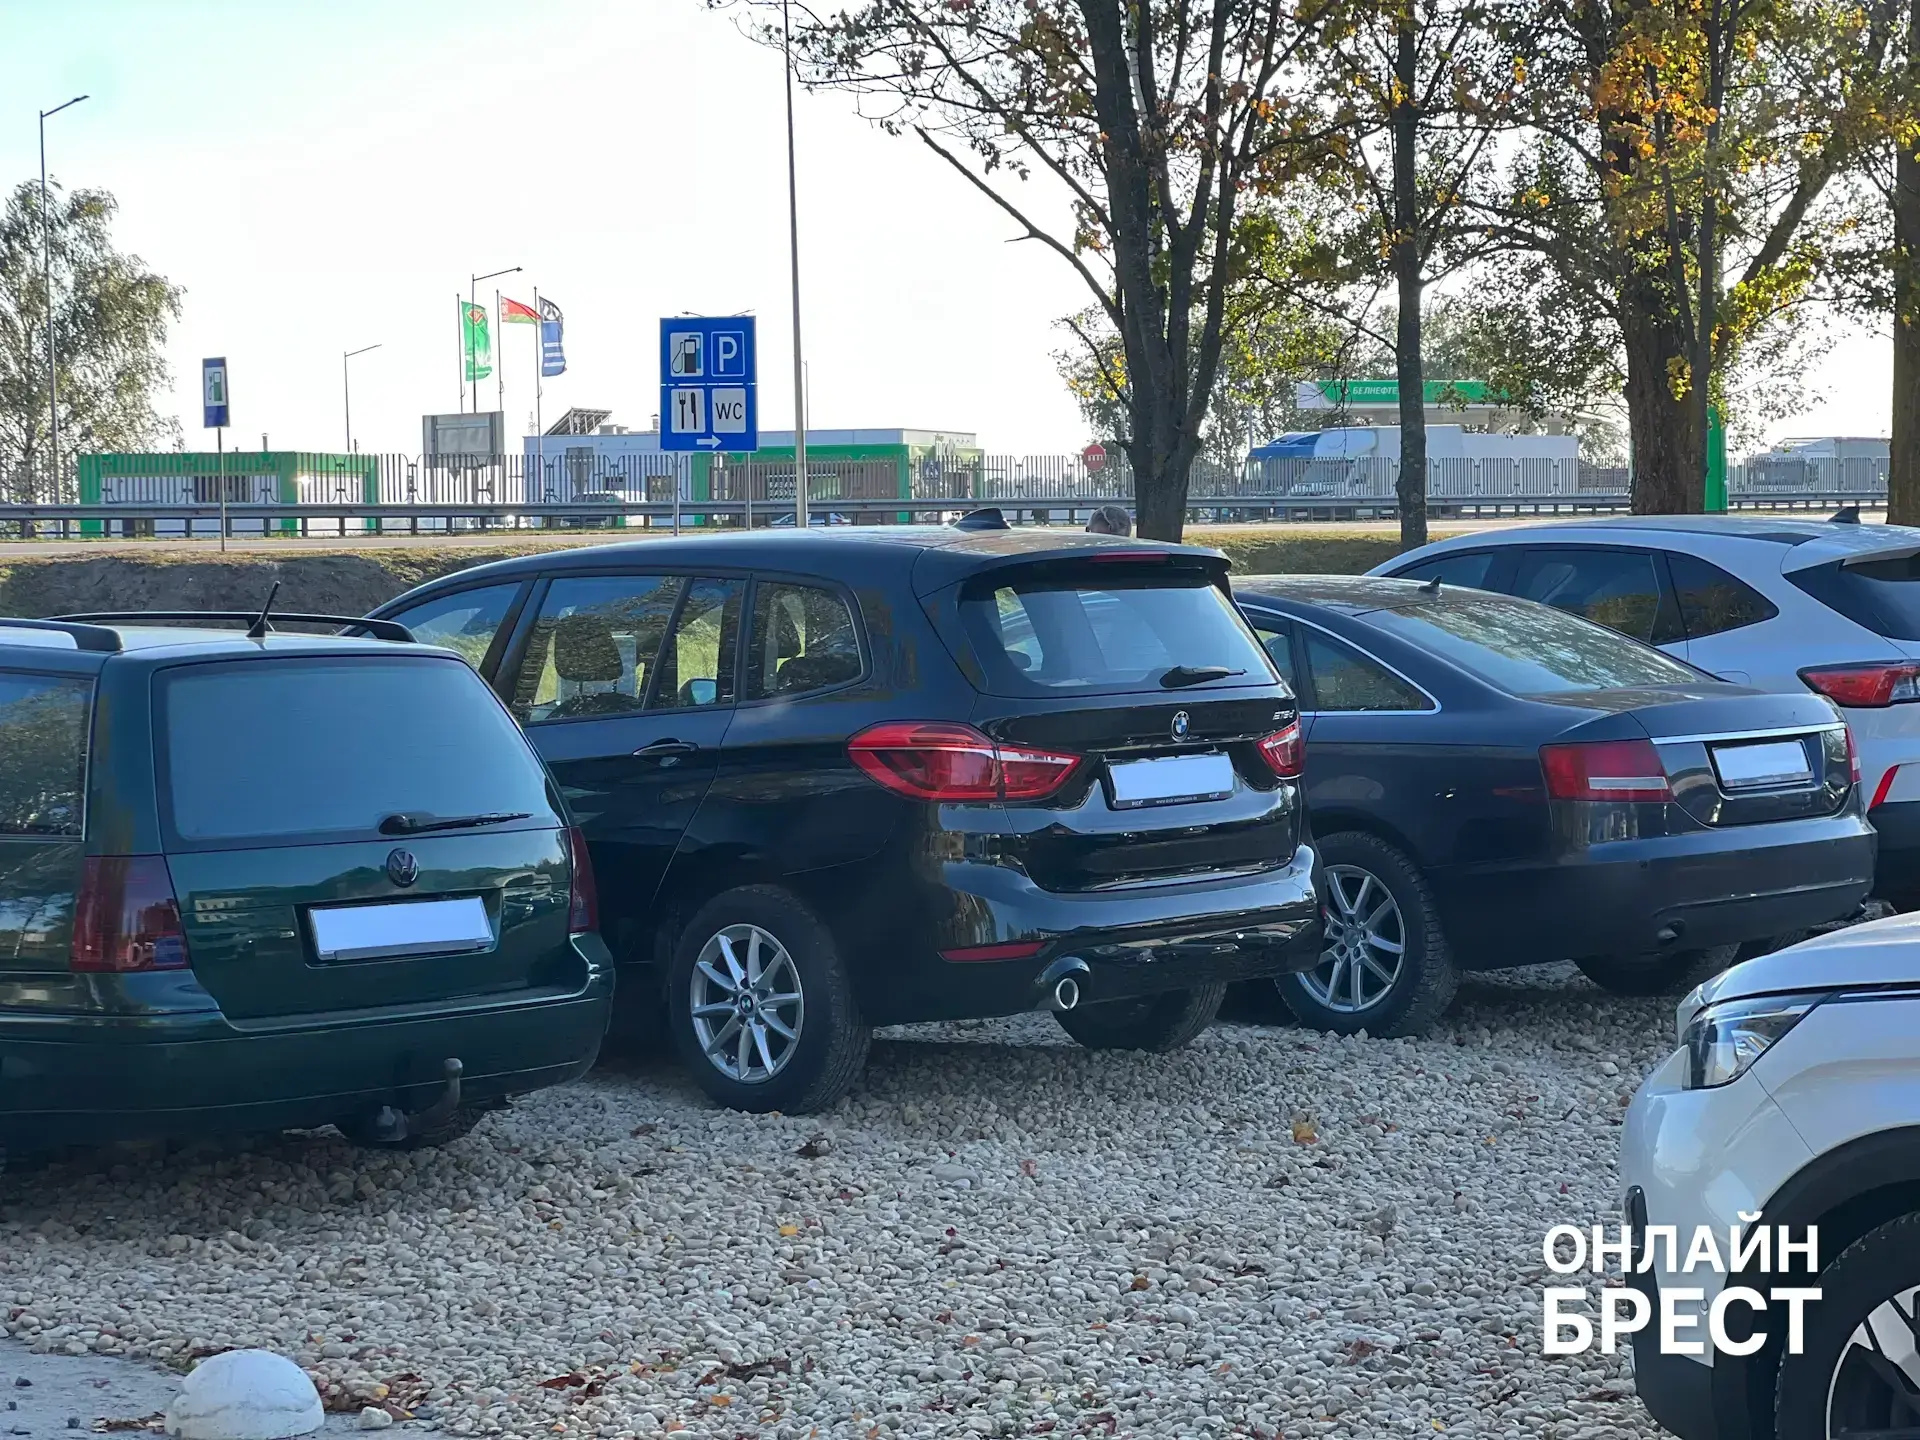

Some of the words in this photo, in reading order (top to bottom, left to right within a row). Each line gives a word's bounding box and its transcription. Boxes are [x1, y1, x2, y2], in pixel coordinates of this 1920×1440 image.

[719, 336, 738, 372] P
[1353, 386, 1399, 395] БЕЛНЕФТЕ
[716, 402, 742, 420] WC
